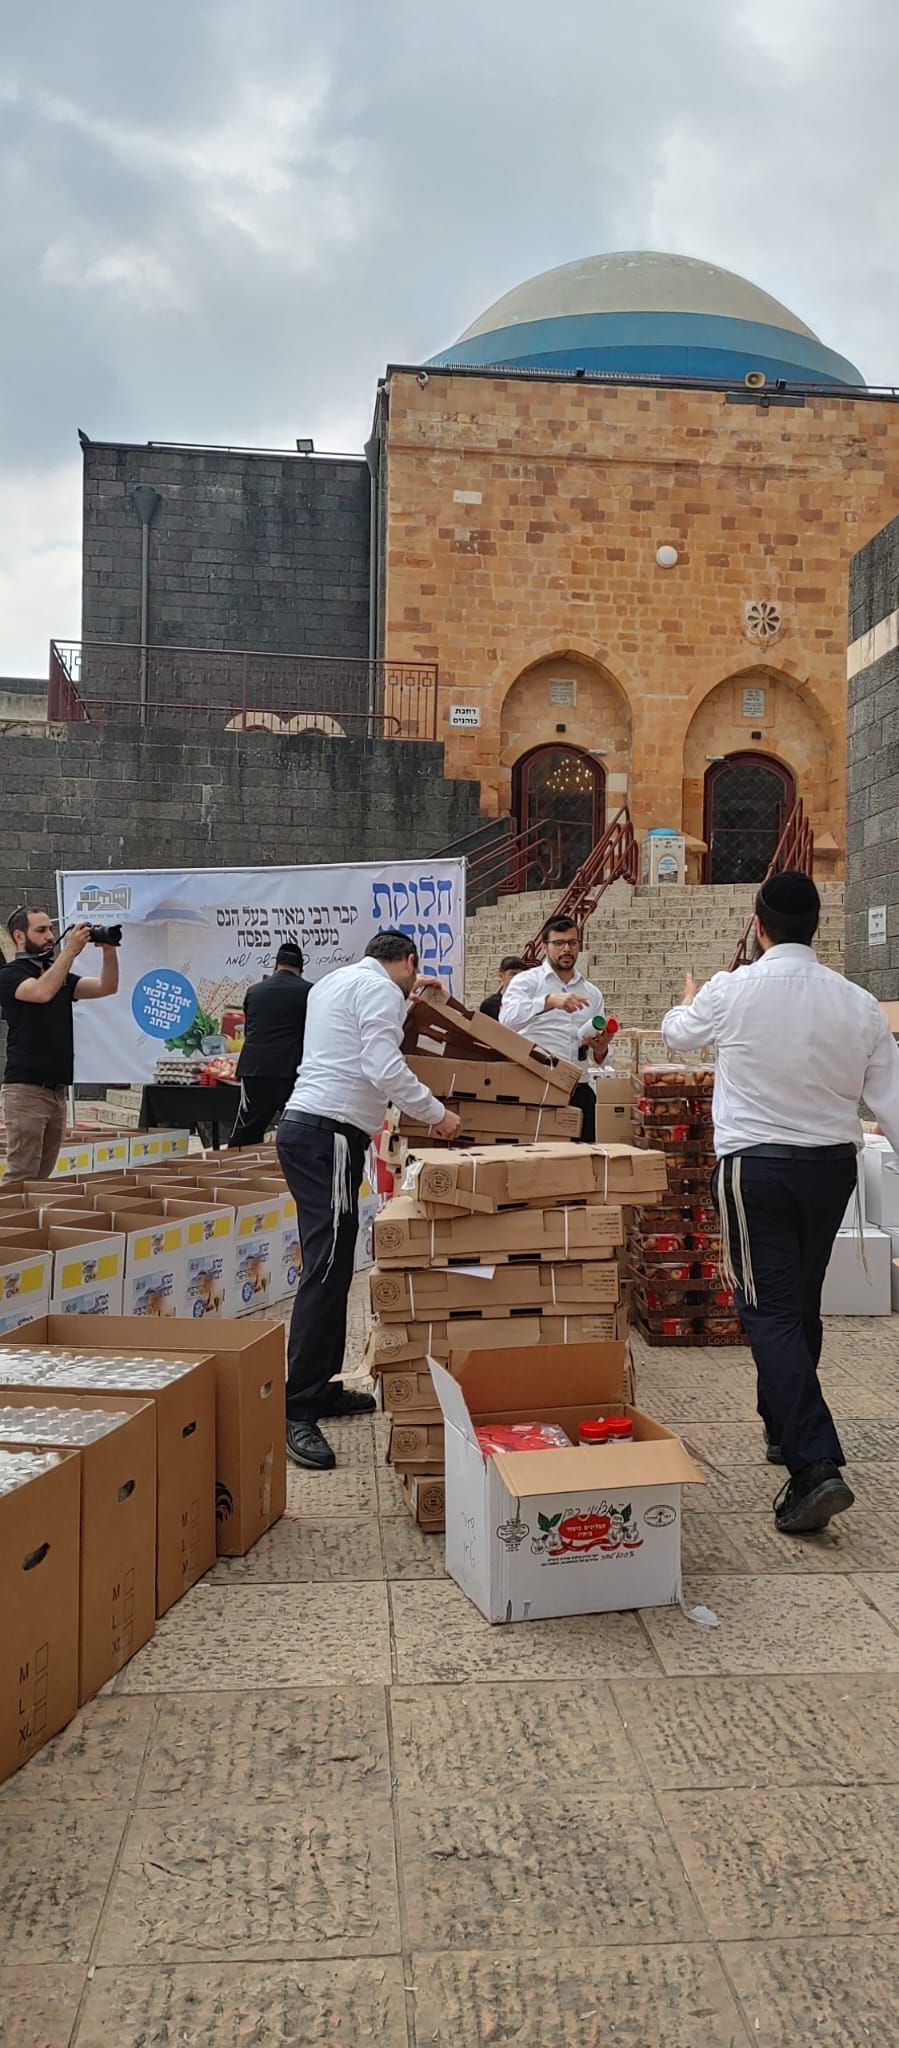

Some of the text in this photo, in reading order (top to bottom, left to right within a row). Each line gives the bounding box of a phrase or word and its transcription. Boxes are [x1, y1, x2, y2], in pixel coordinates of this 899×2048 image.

[453, 717, 478, 725] כוהנים
[372, 876, 452, 921] חלוקת
[216, 905, 359, 927] קבר רבי מאיר בעל הנס
[237, 929, 271, 947] בפסח
[302, 928, 340, 949] מעניק
[156, 979, 182, 995] כי כל
[143, 985, 192, 1008] אחד זכאי
[149, 997, 181, 1013] לכבוד
[143, 1005, 181, 1023] ושמחה
[149, 1016, 171, 1030] בחג
[707, 1307, 738, 1317] Cookie
[708, 1336, 744, 1345] Cookies
[19, 1663, 29, 1684] M
[18, 1698, 25, 1715] L
[18, 1727, 33, 1747] XL
